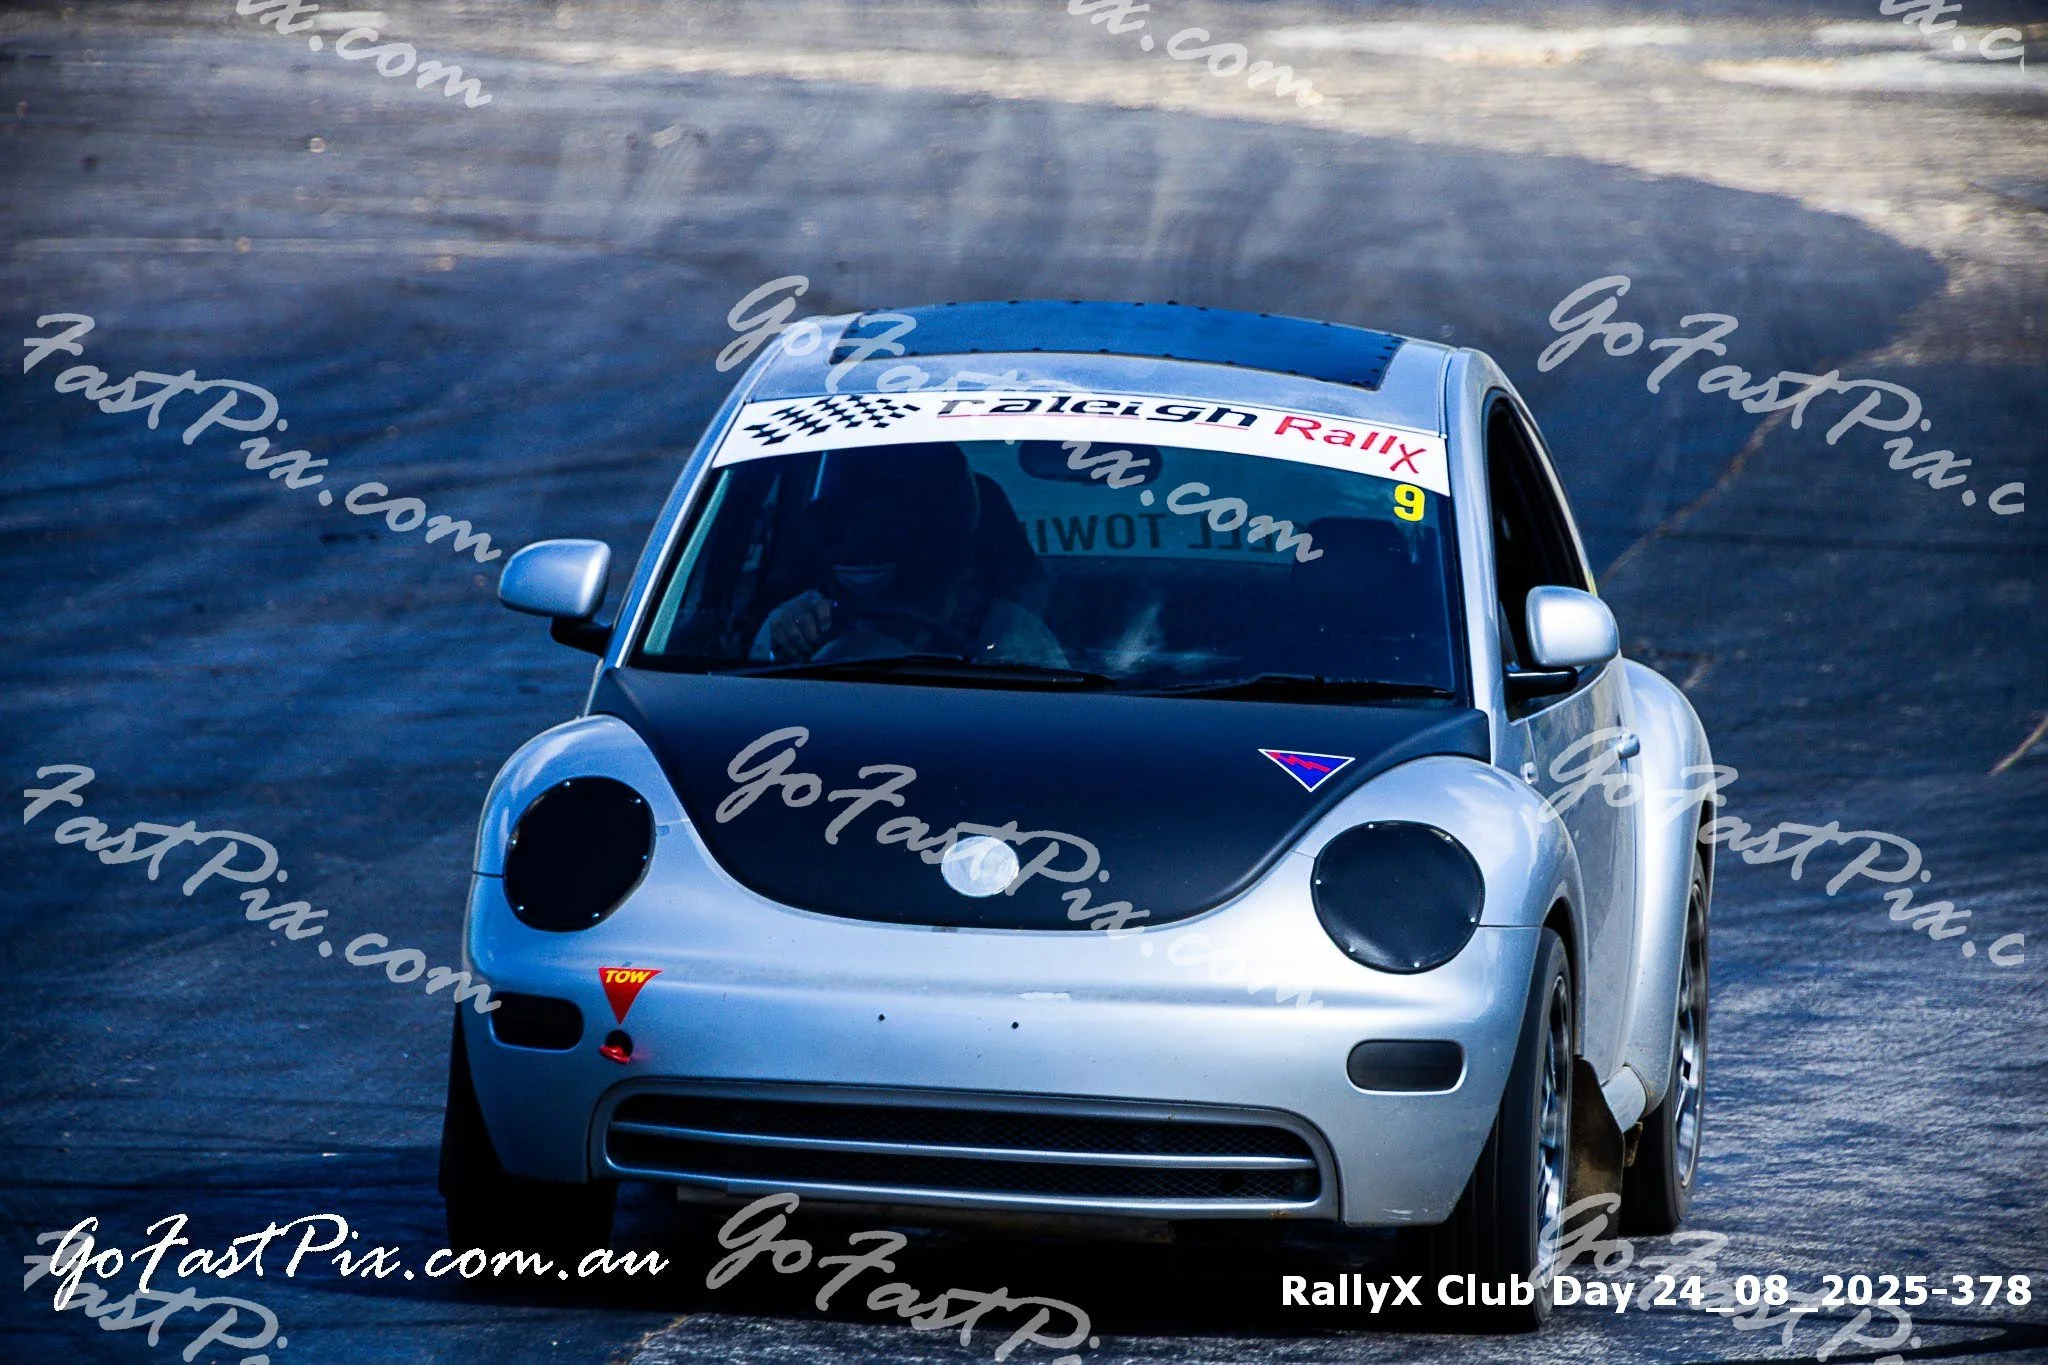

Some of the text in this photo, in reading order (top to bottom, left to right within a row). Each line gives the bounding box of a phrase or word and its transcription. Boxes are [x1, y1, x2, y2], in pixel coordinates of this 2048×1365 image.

[937, 395, 1258, 428] raleigh
[1393, 483, 1425, 522] 9
[605, 969, 651, 984] TOW
